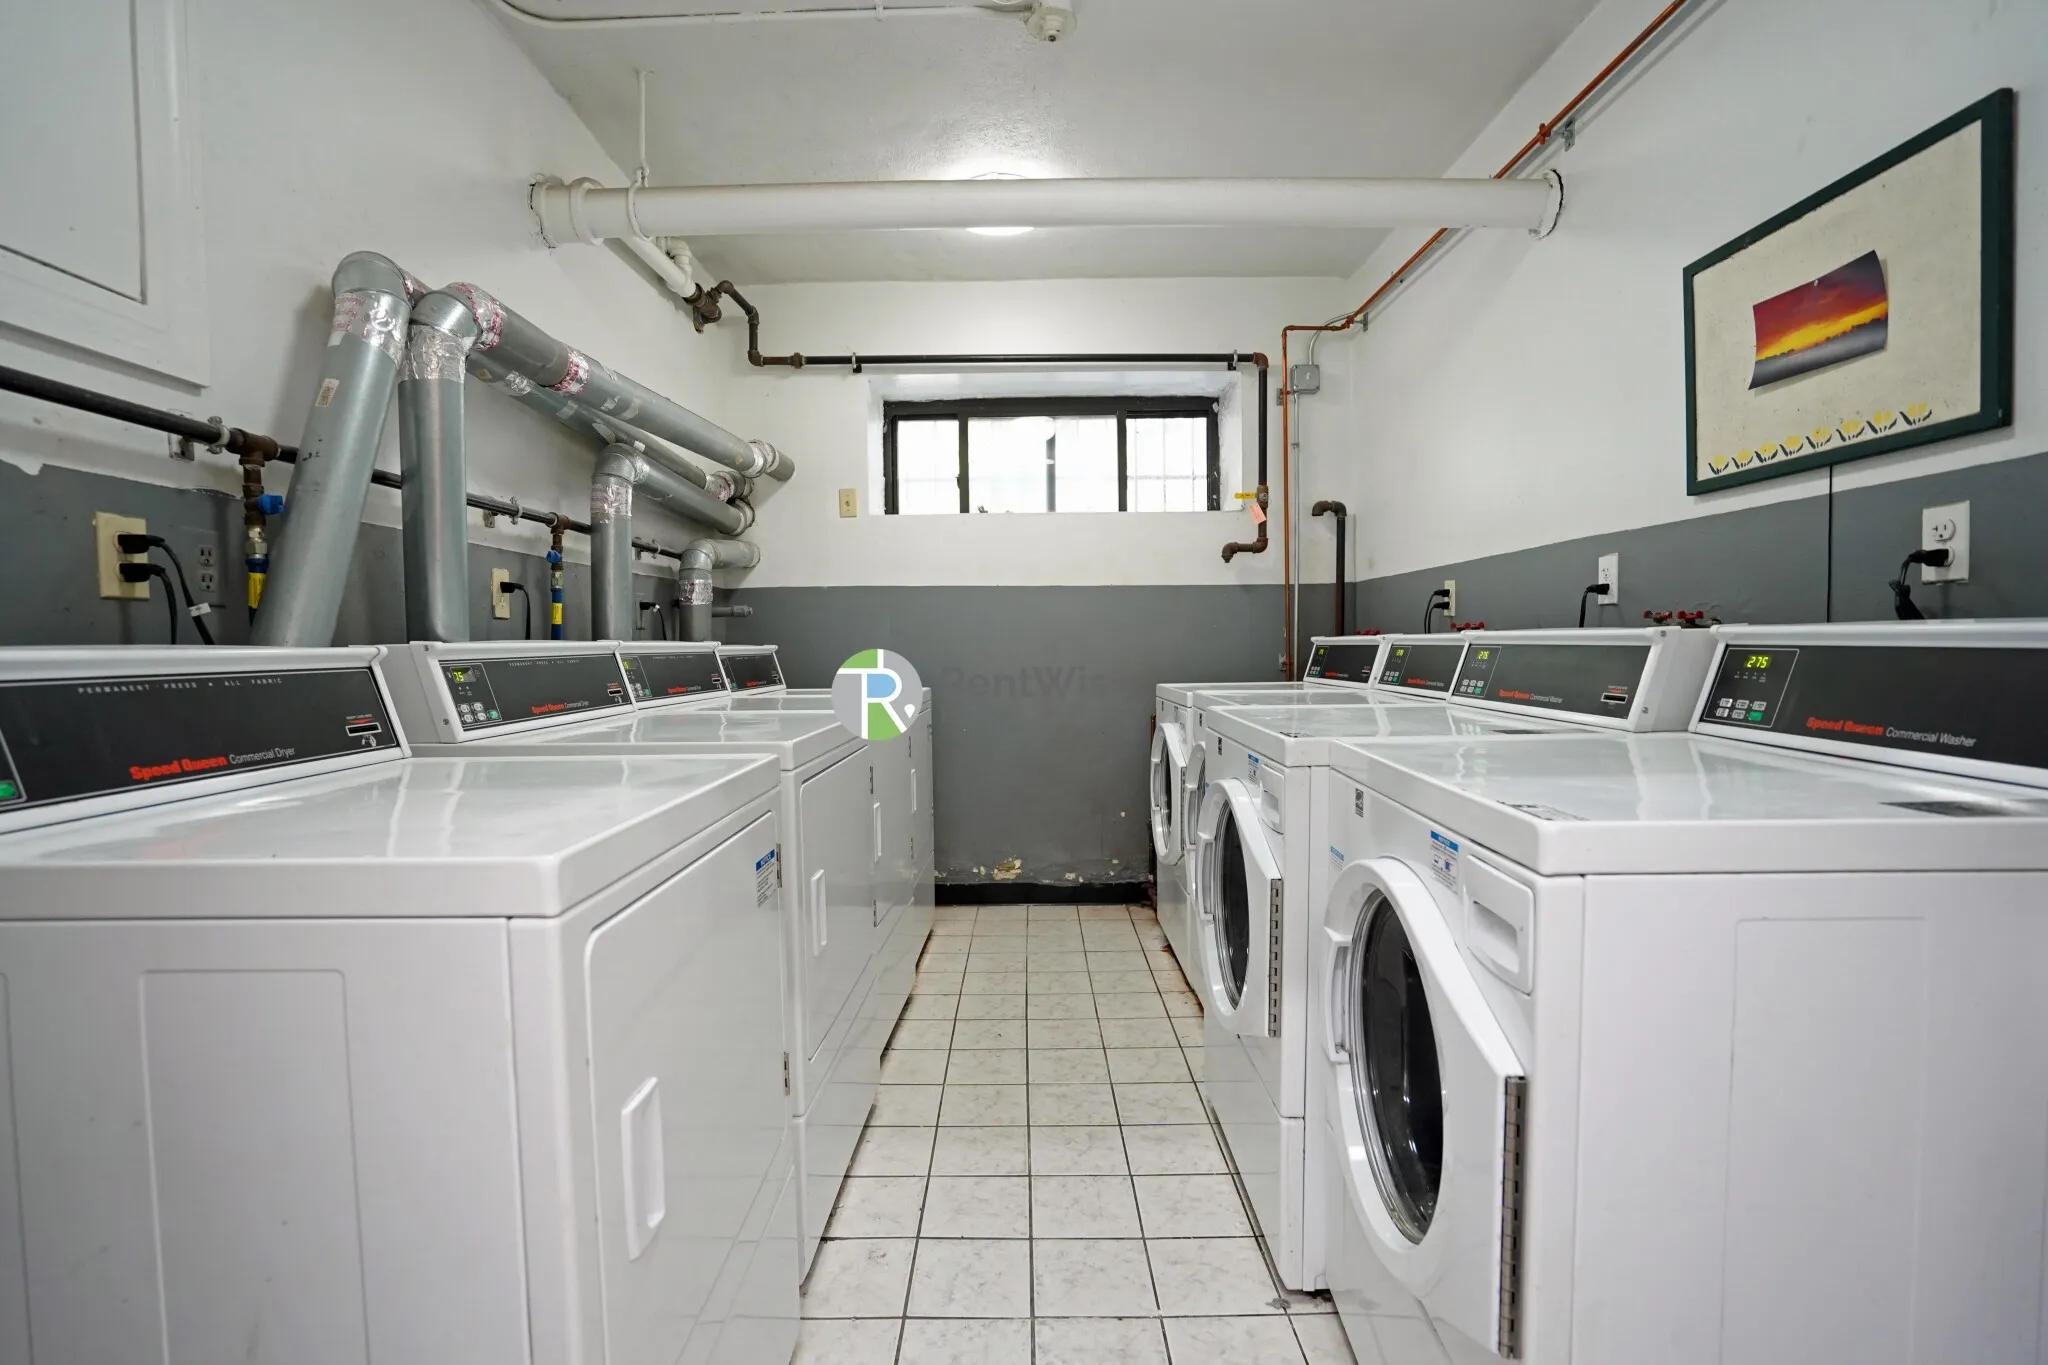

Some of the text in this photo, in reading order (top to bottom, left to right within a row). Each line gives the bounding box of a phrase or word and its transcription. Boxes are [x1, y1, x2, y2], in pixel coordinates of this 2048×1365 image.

[1746, 656, 1769, 668] 275
[77, 683, 150, 695] PERMANENT
[163, 681, 198, 690] PRESS
[1806, 716, 1977, 747] Speed Queen Commercial Washer
[129, 746, 296, 781] Speed Queen Commercial Dryer
